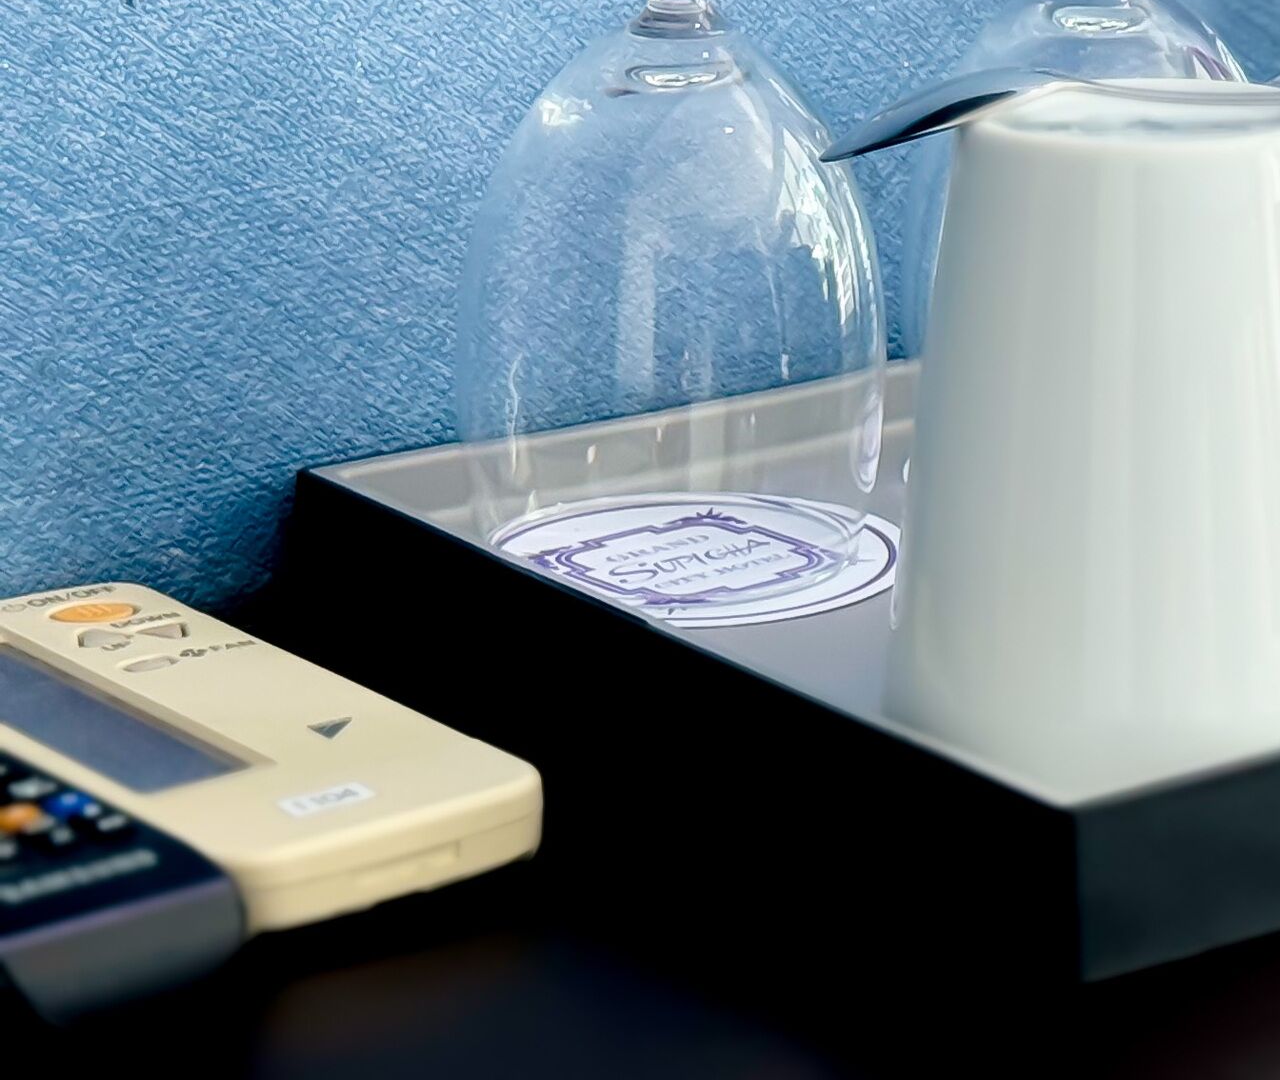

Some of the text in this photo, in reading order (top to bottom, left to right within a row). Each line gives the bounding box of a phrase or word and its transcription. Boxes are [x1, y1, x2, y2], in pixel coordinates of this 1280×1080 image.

[605, 534, 710, 563] GRAND
[654, 571, 708, 589] CITY
[27, 584, 117, 608] ON/OFF
[110, 611, 182, 629] DOWN
